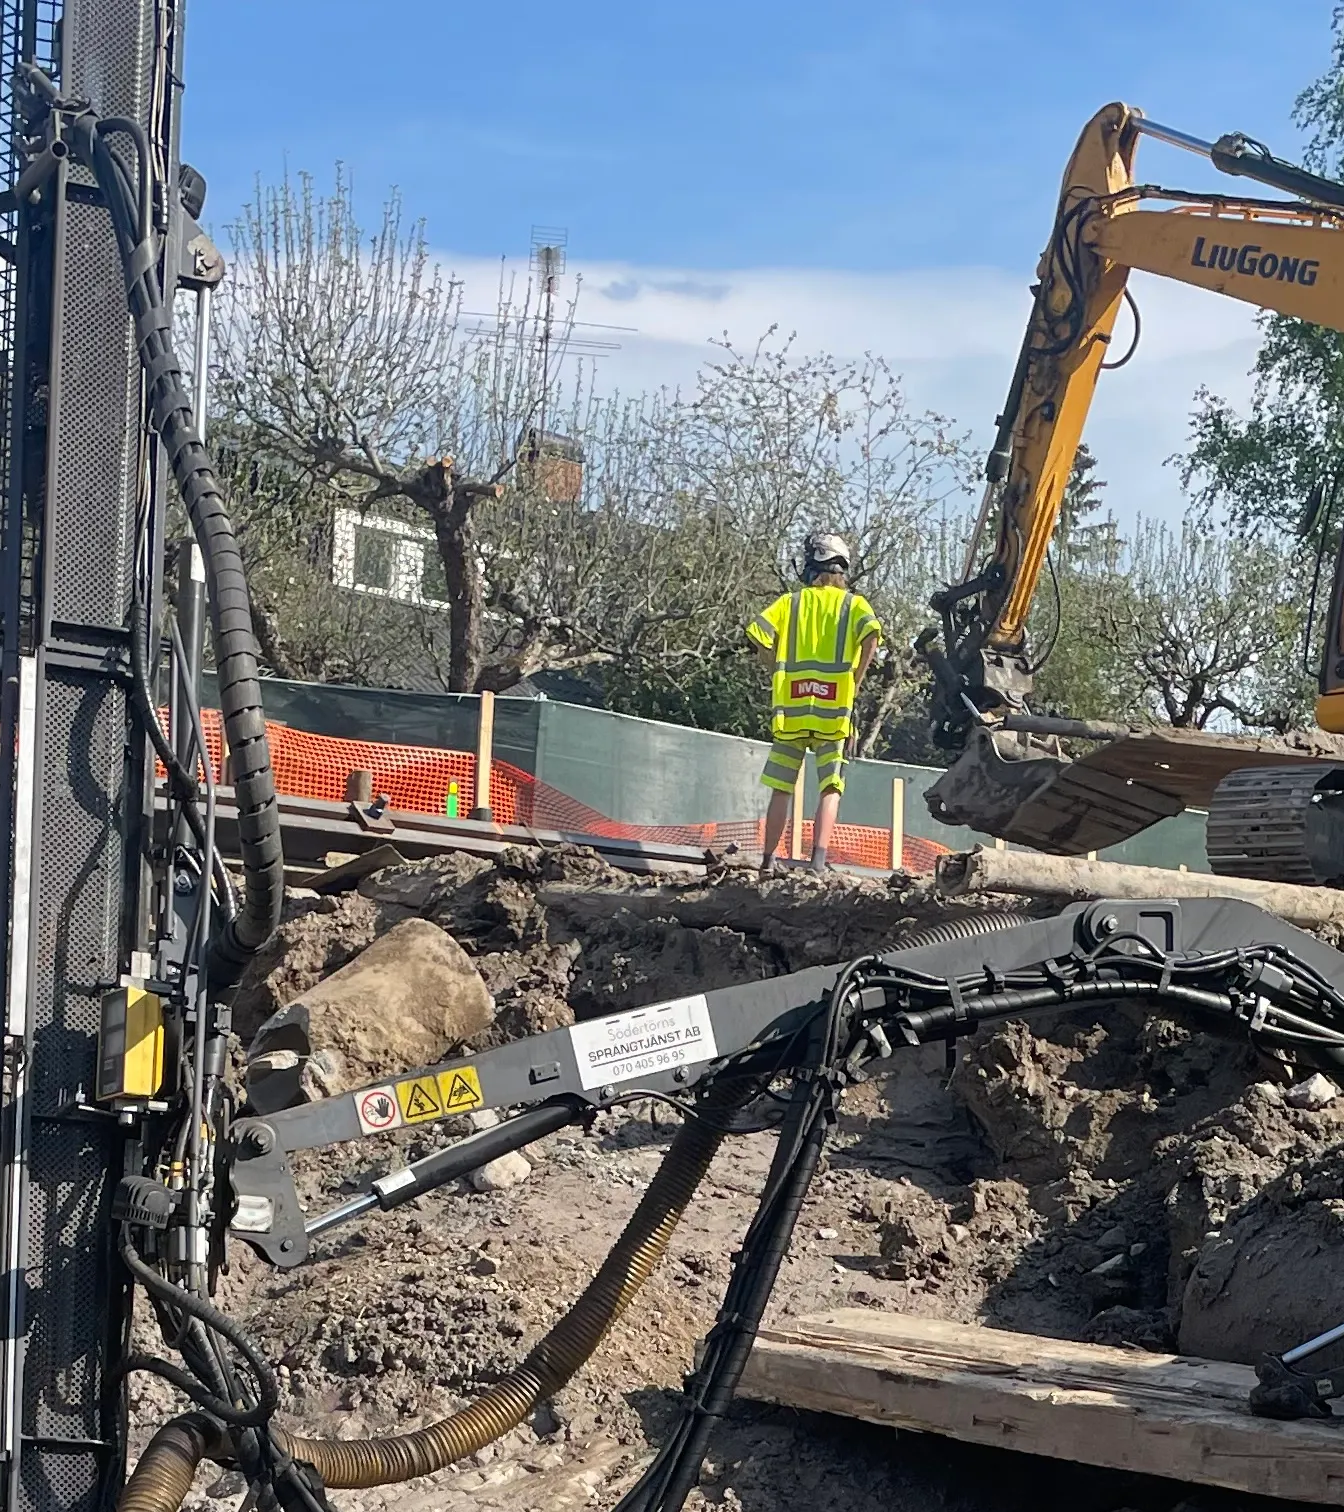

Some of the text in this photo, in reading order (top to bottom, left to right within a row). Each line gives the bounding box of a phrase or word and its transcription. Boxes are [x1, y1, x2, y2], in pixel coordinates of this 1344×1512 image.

[607, 1017, 676, 1042] Södertörns
[684, 1026, 702, 1039] AB
[612, 1048, 685, 1076] 070 405 96 95
